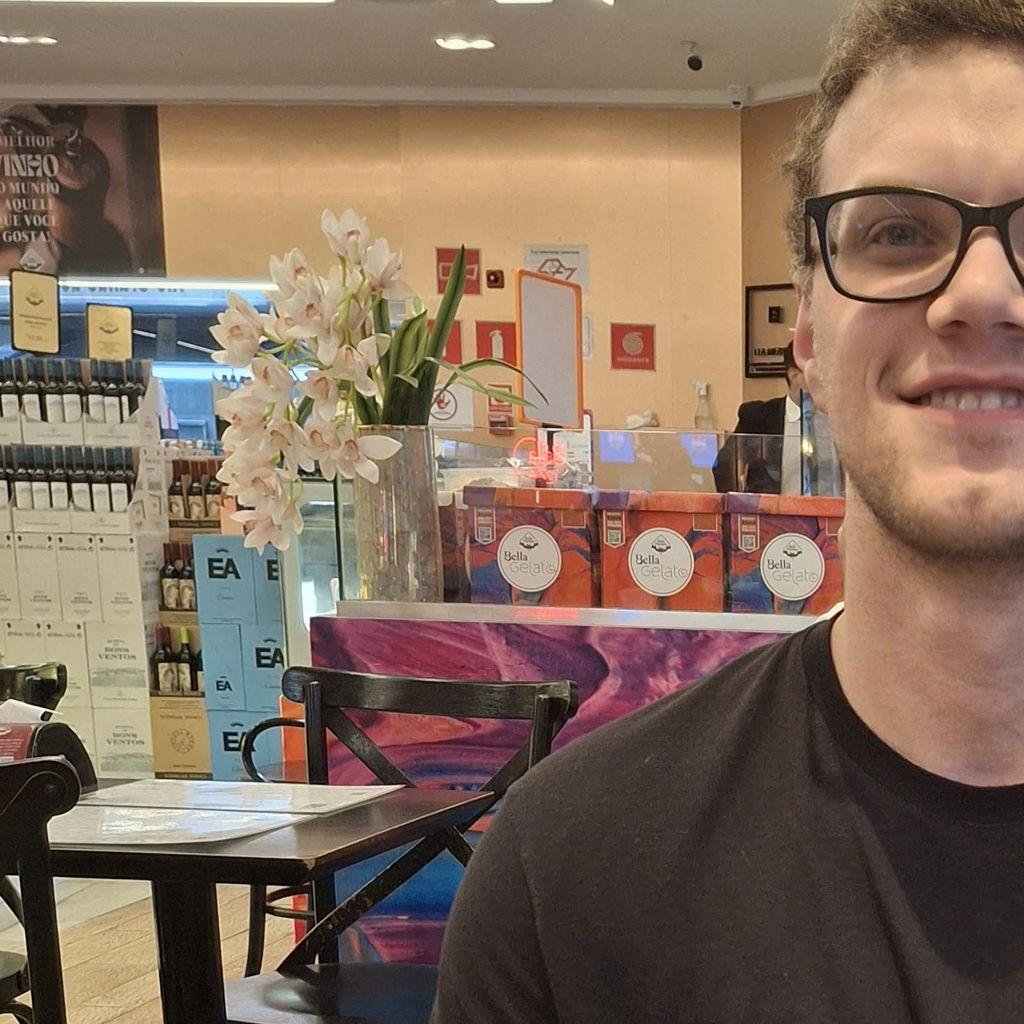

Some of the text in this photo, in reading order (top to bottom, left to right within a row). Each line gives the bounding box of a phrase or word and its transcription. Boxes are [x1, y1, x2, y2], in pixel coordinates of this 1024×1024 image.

[0, 153, 59, 177] INHO
[9, 182, 60, 194] MUNDO
[504, 550, 528, 562] Bella
[635, 554, 660, 565] Bella
[207, 557, 241, 580] EA
[266, 559, 279, 581] E
[509, 562, 555, 576] Gelato
[767, 559, 791, 569] Bella
[640, 565, 688, 580] Gelato
[772, 569, 819, 585] Gelato
[255, 647, 284, 668] EA
[216, 680, 232, 691] EA
